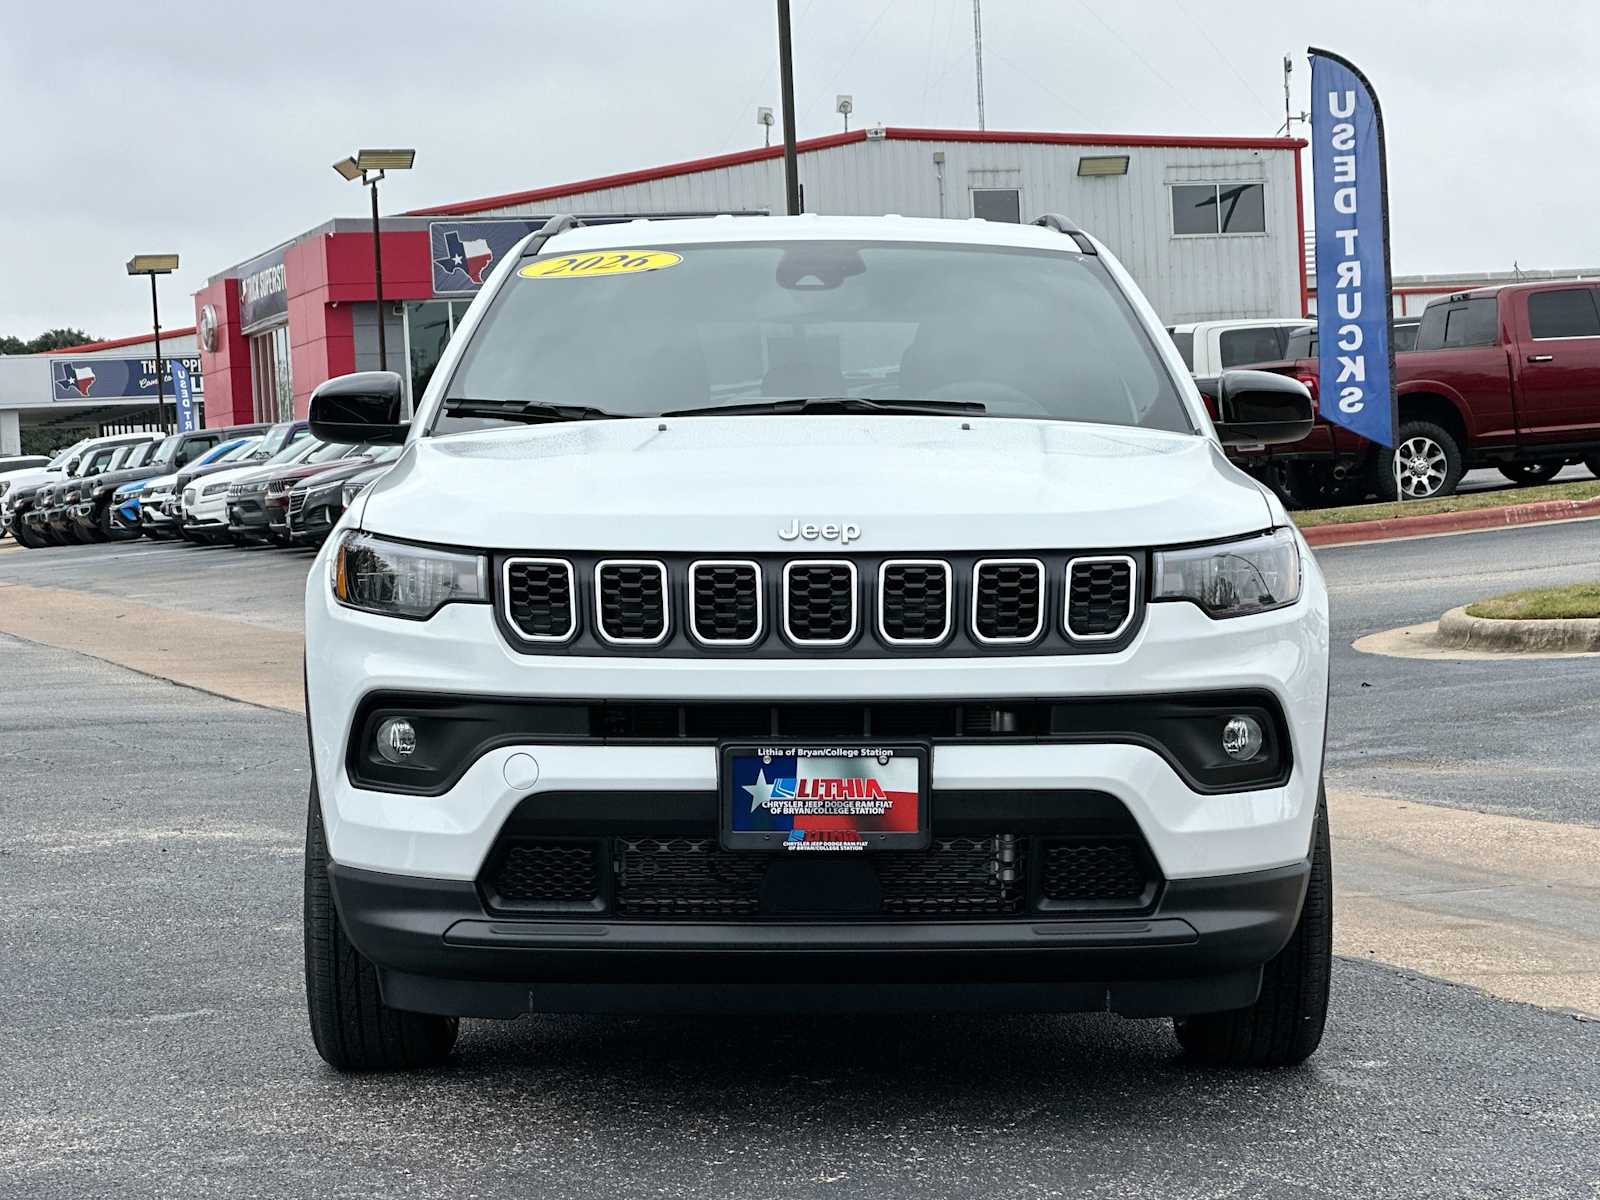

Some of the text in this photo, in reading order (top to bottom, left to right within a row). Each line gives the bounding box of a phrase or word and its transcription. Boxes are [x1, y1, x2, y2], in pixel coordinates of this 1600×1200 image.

[541, 254, 660, 276] 2026
[778, 519, 861, 545] Jeep
[758, 748, 893, 758] Lithia of Bryan/College Station
[795, 778, 887, 800] LITHIA
[770, 807, 885, 815] OF BRYAN/COLLEGE STATION
